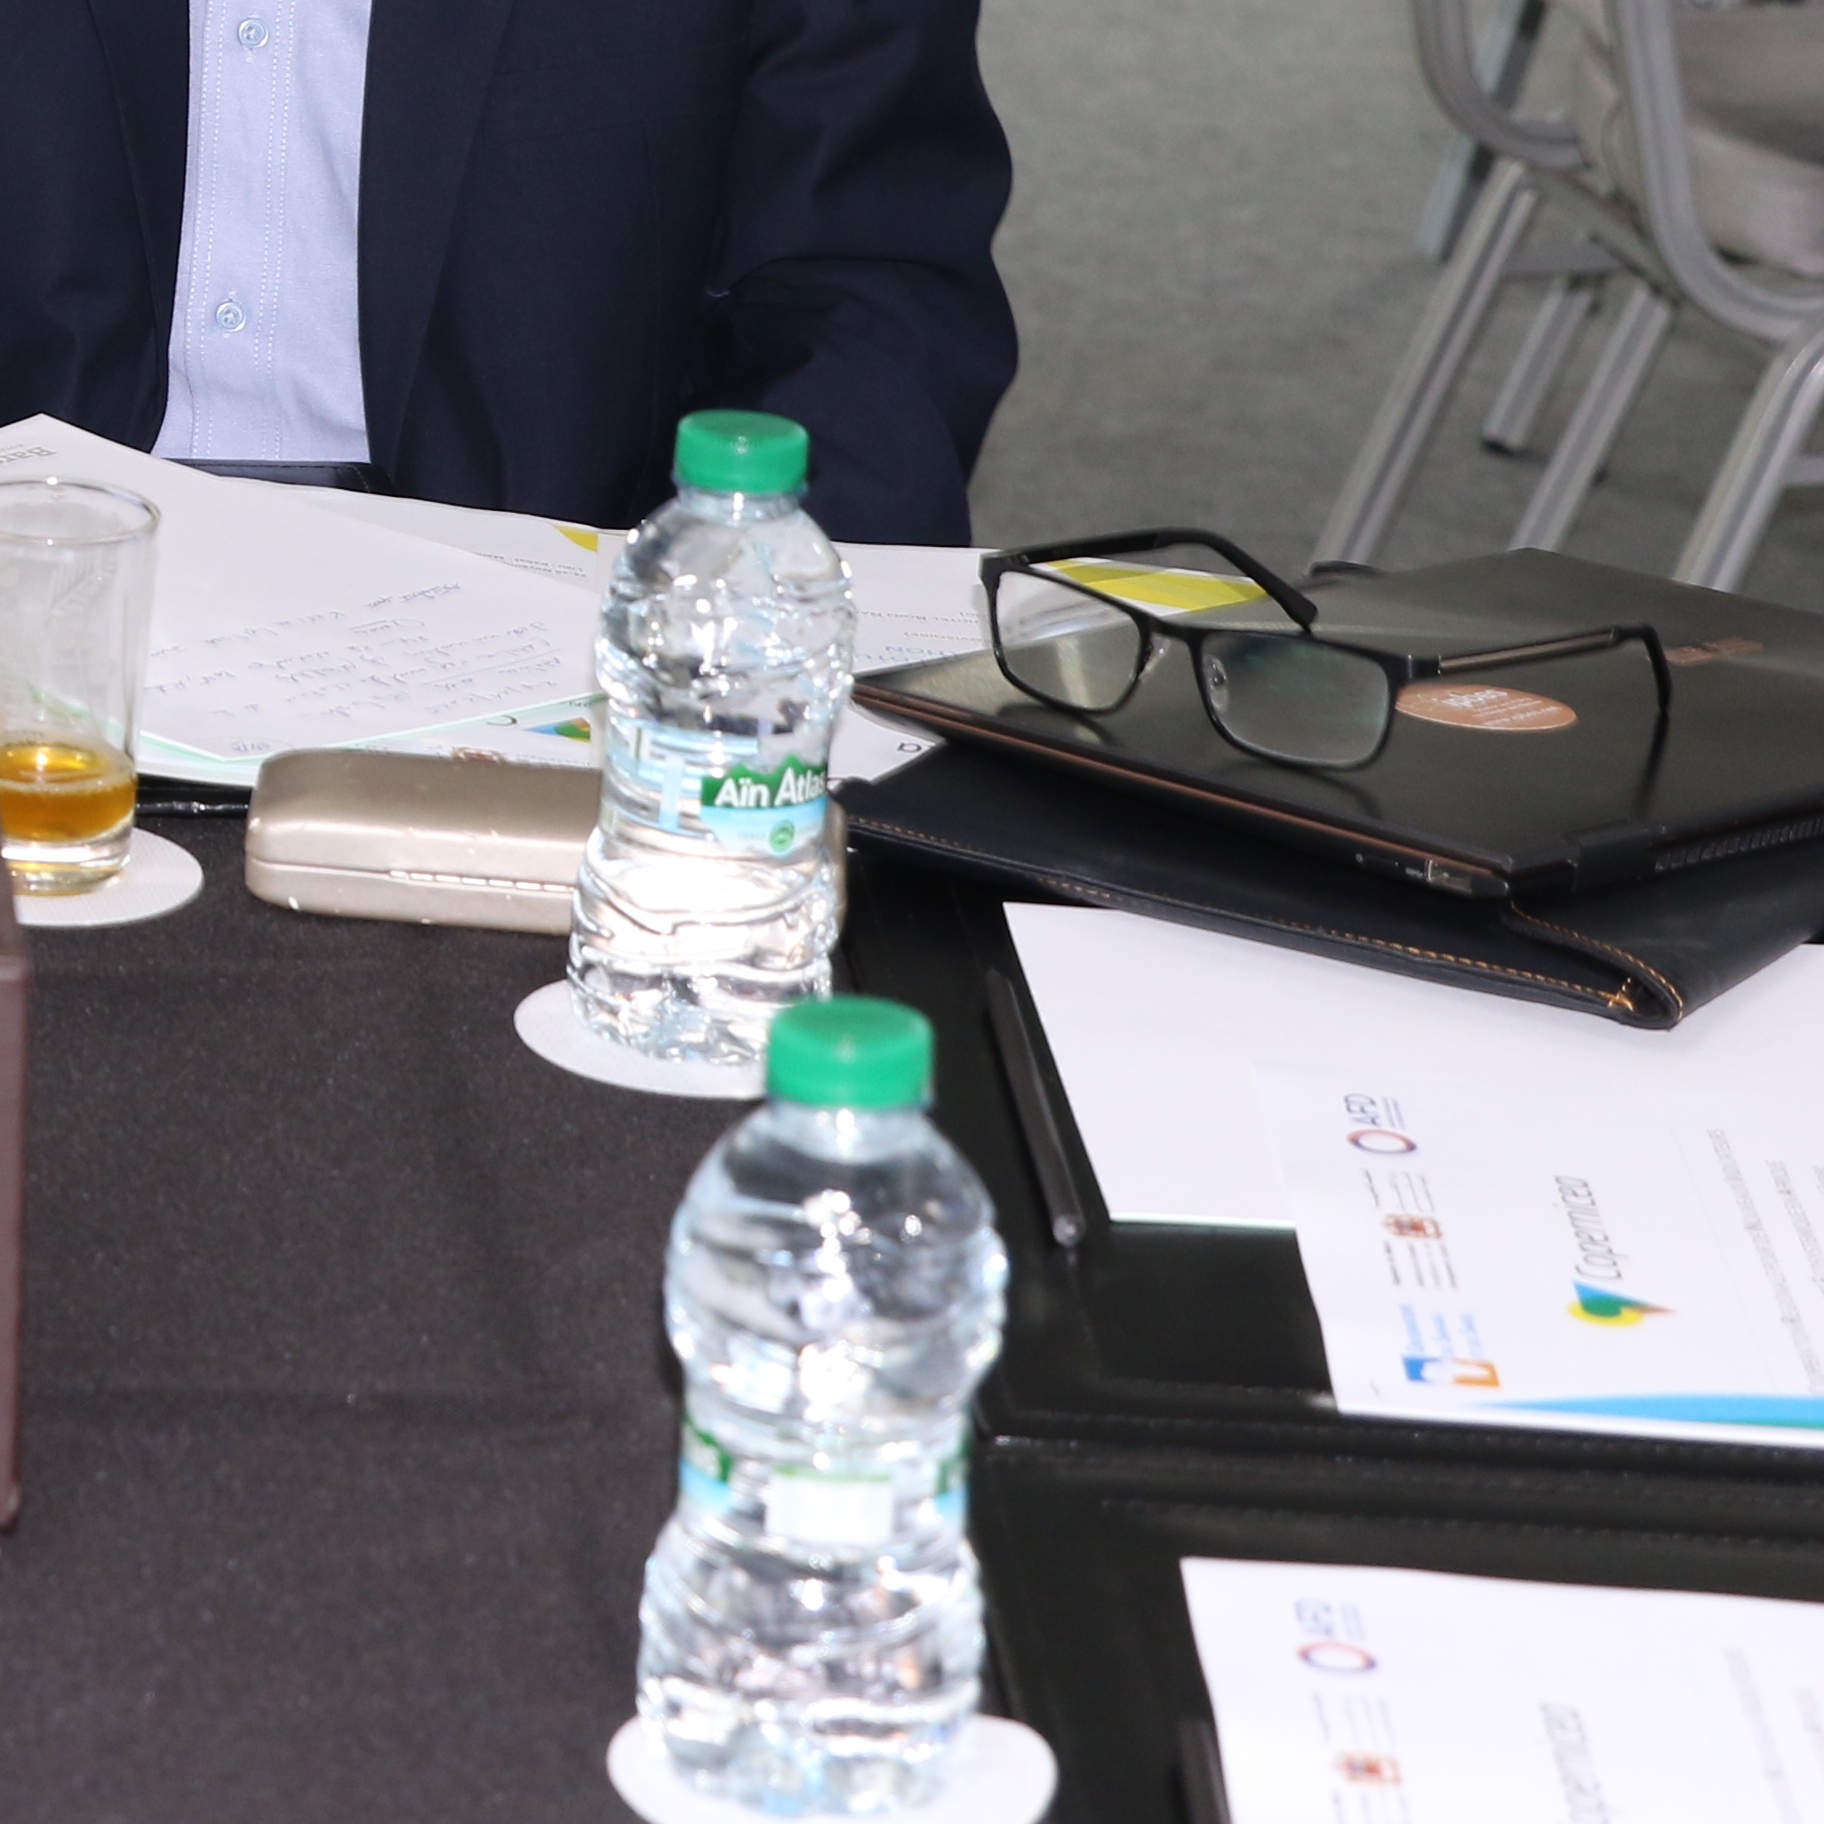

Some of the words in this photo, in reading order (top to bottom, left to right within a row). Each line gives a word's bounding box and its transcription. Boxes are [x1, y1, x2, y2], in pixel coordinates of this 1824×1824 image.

[713, 776, 771, 808] Aïn
[1343, 1093, 1380, 1127] AFD
[1553, 1175, 1629, 1280] Copernicea
